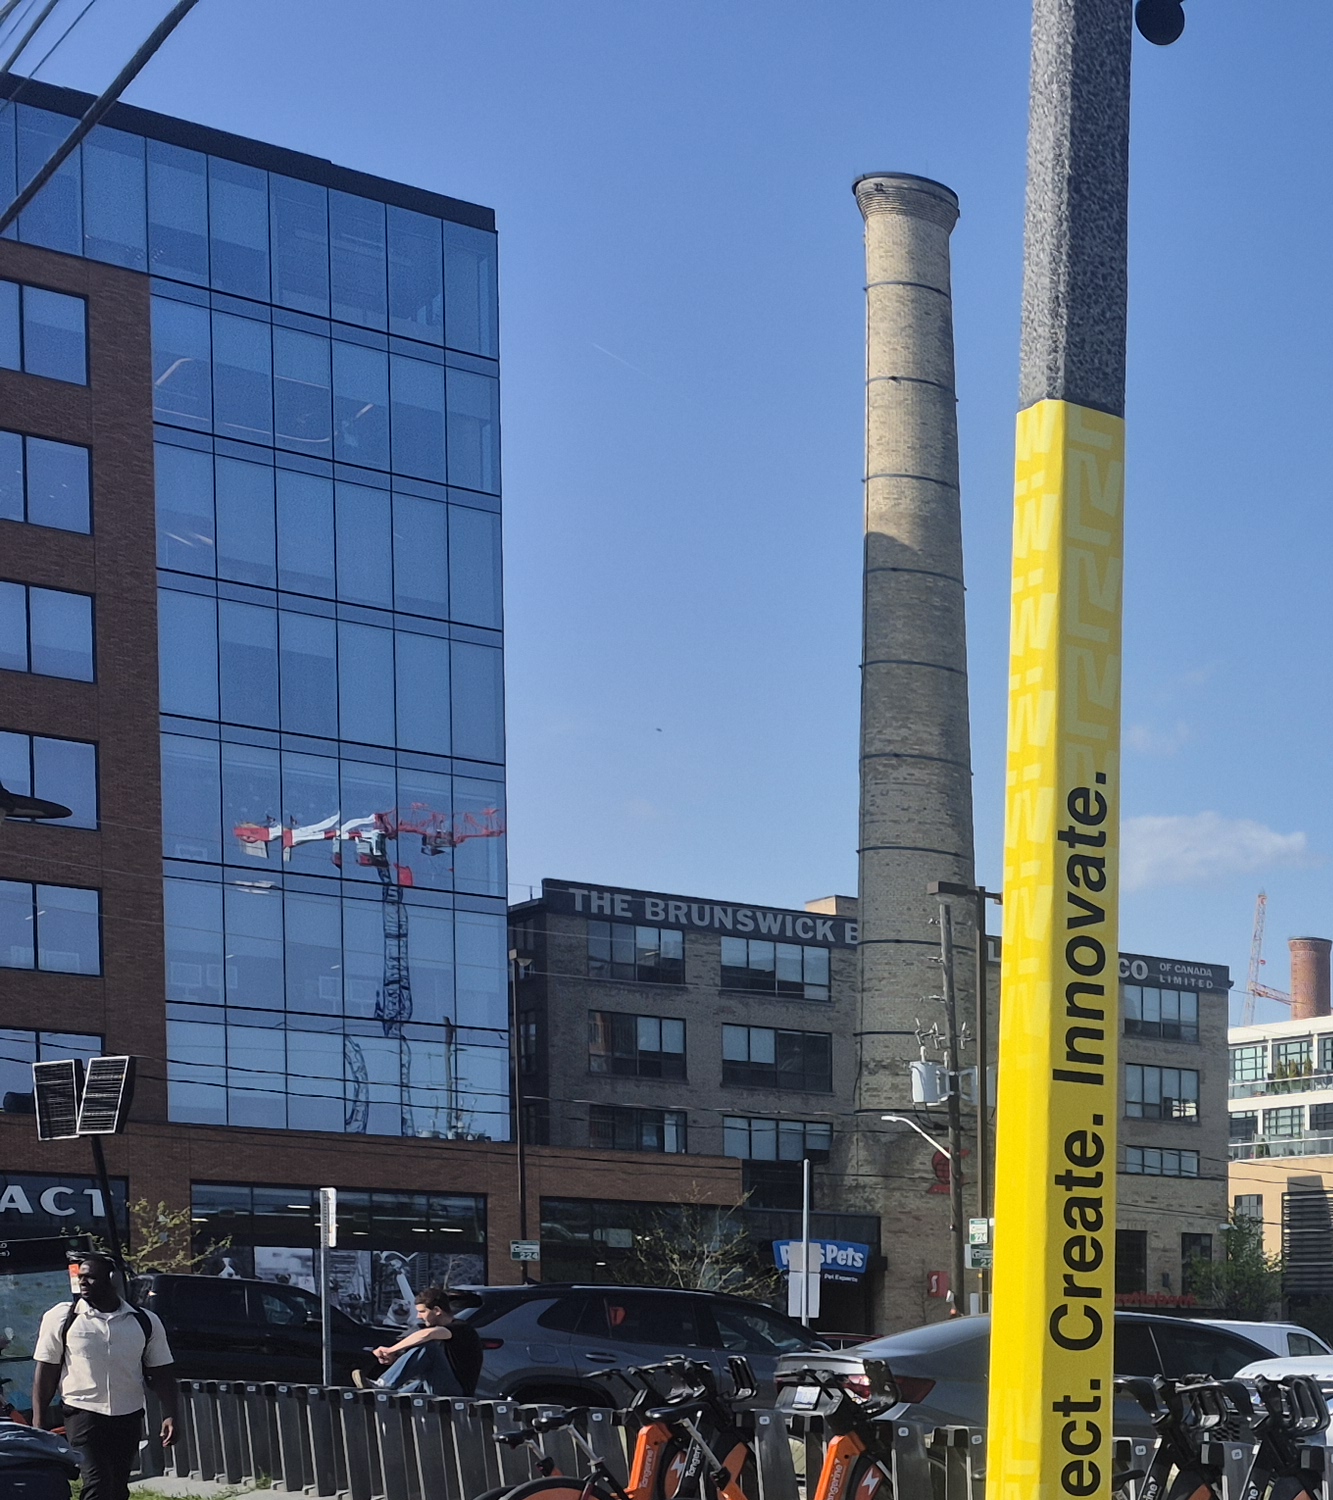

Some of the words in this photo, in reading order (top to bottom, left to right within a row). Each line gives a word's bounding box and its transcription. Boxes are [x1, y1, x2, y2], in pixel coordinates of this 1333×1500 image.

[568, 887, 632, 918] THE
[645, 898, 835, 942] BRUNSWICK
[1053, 772, 1107, 1085] Innovate.
[1159, 962, 1172, 972] OF
[1174, 964, 1213, 977] CANADA
[1159, 974, 1214, 989] LIMITED
[1050, 1113, 1105, 1351] Create.
